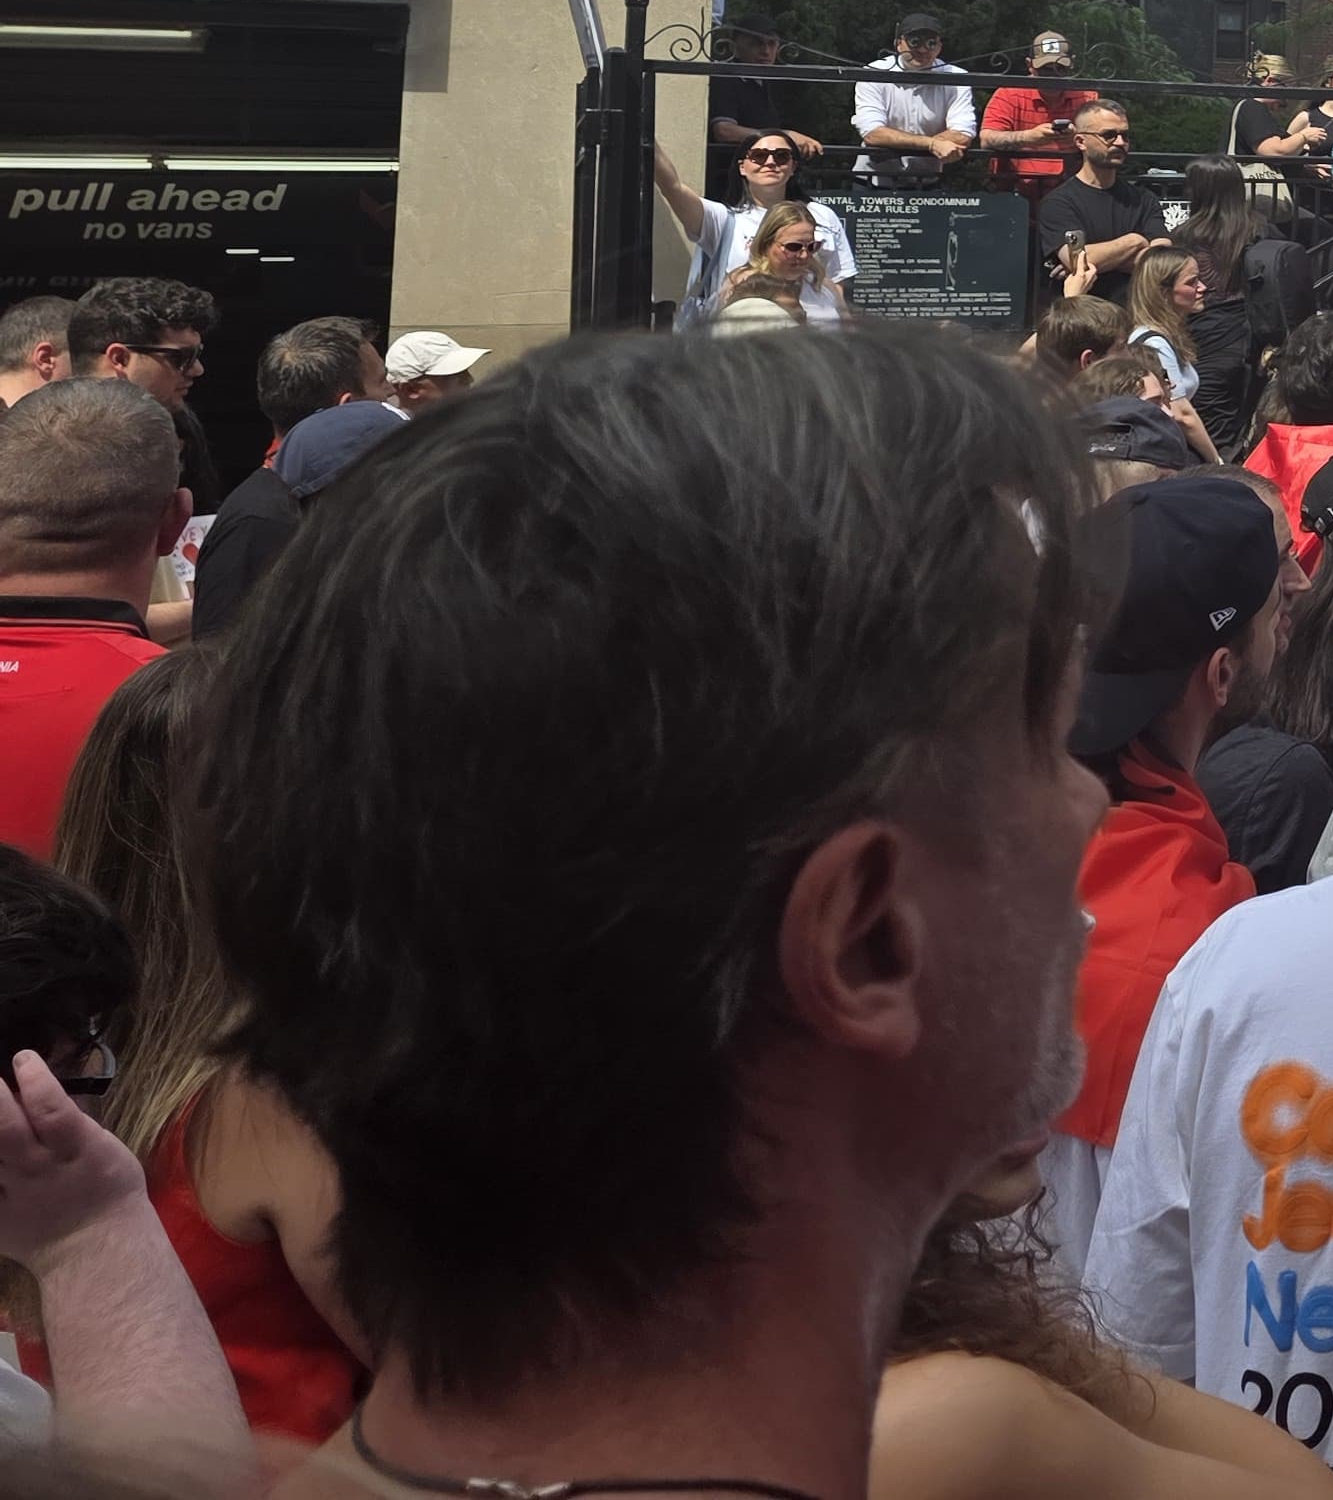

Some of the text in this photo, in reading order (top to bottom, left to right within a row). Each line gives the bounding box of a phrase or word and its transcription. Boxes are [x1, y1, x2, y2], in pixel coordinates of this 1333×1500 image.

[8, 182, 288, 219] pull ahead
[861, 197, 904, 206] TOWERS
[909, 198, 980, 206] CONDOMINIUM
[846, 205, 919, 214] PLAZA RULES
[82, 221, 213, 240] no vans
